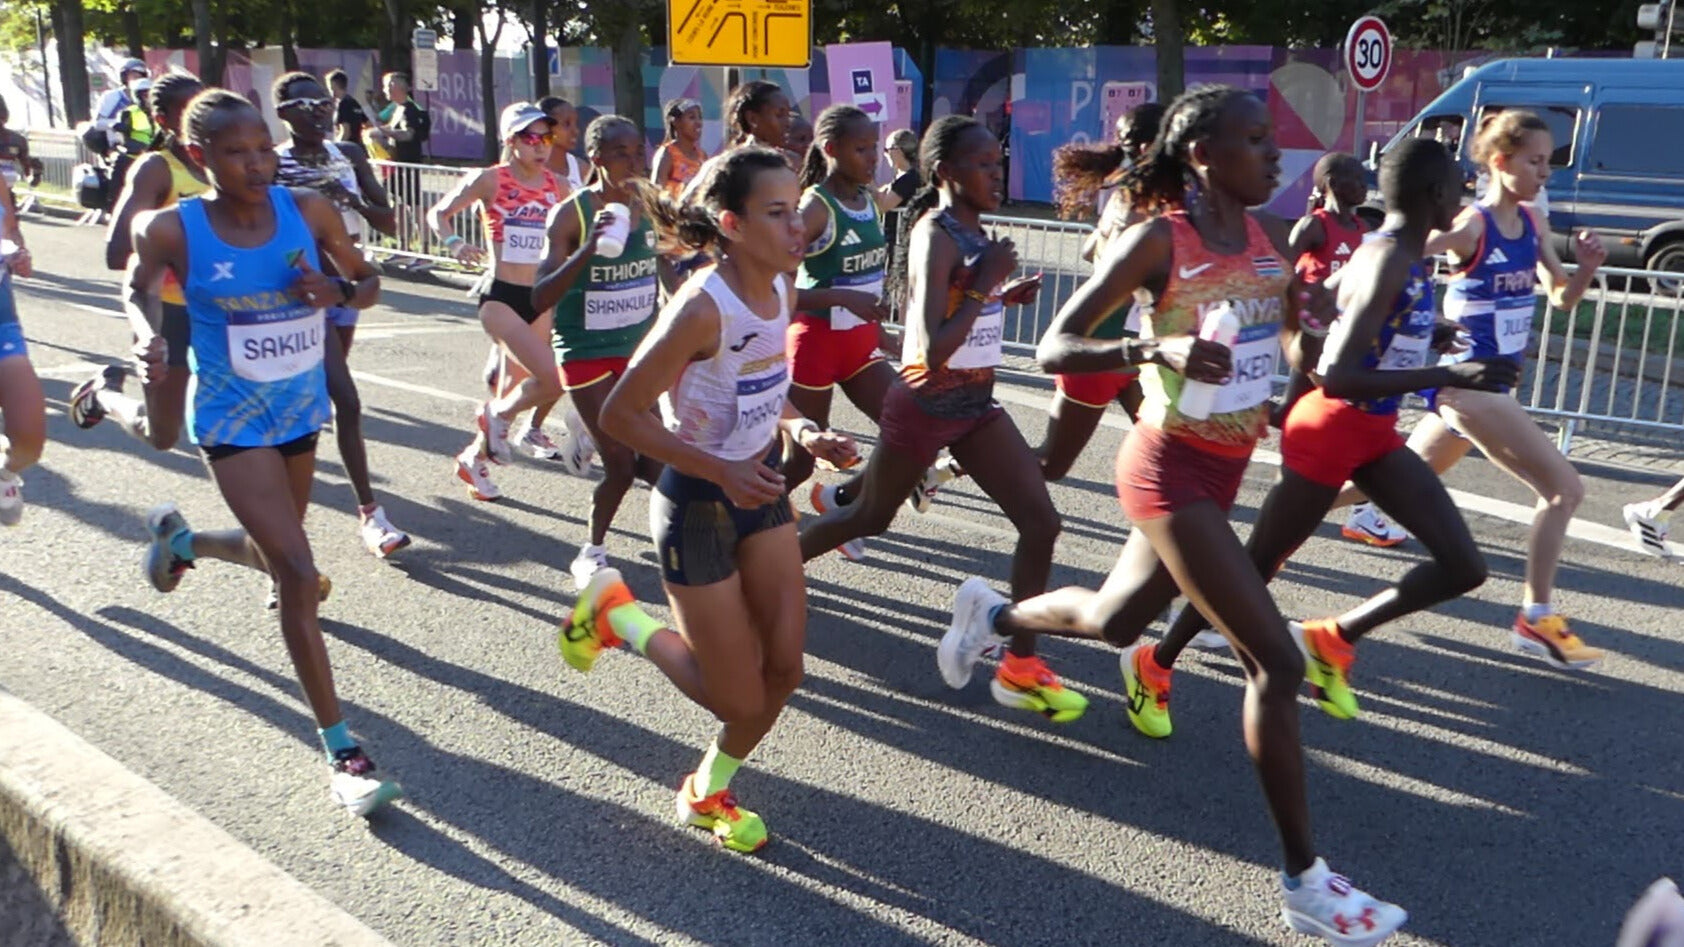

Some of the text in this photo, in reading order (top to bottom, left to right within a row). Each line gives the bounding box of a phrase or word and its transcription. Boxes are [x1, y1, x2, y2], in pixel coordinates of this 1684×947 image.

[1357, 39, 1382, 69] 30
[855, 77, 869, 87] TA
[243, 325, 320, 360] SAKILU
